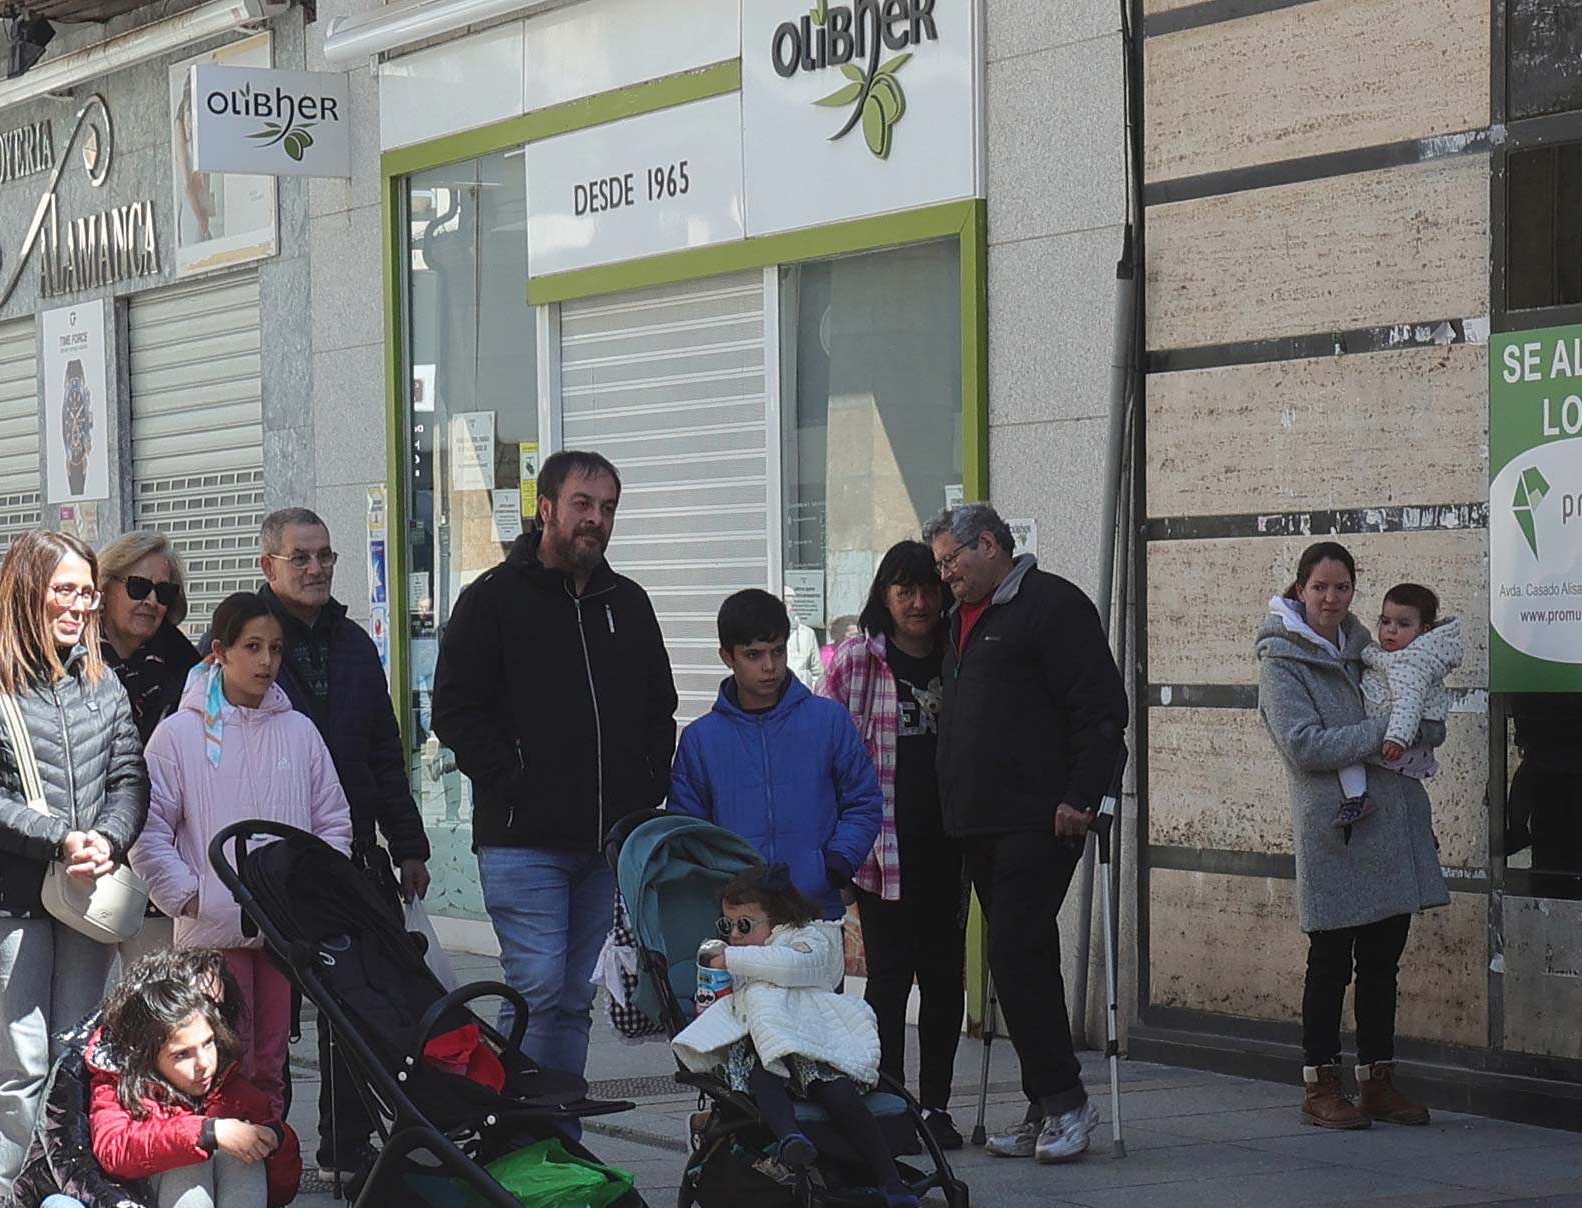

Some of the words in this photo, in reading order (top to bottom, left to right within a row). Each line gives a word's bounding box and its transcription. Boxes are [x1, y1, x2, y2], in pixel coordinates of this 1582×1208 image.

[574, 173, 634, 216] DESDE
[647, 160, 690, 201] 1965
[1503, 342, 1542, 384] SE
[1499, 583, 1524, 598] Avda.
[1526, 580, 1560, 597] Casado
